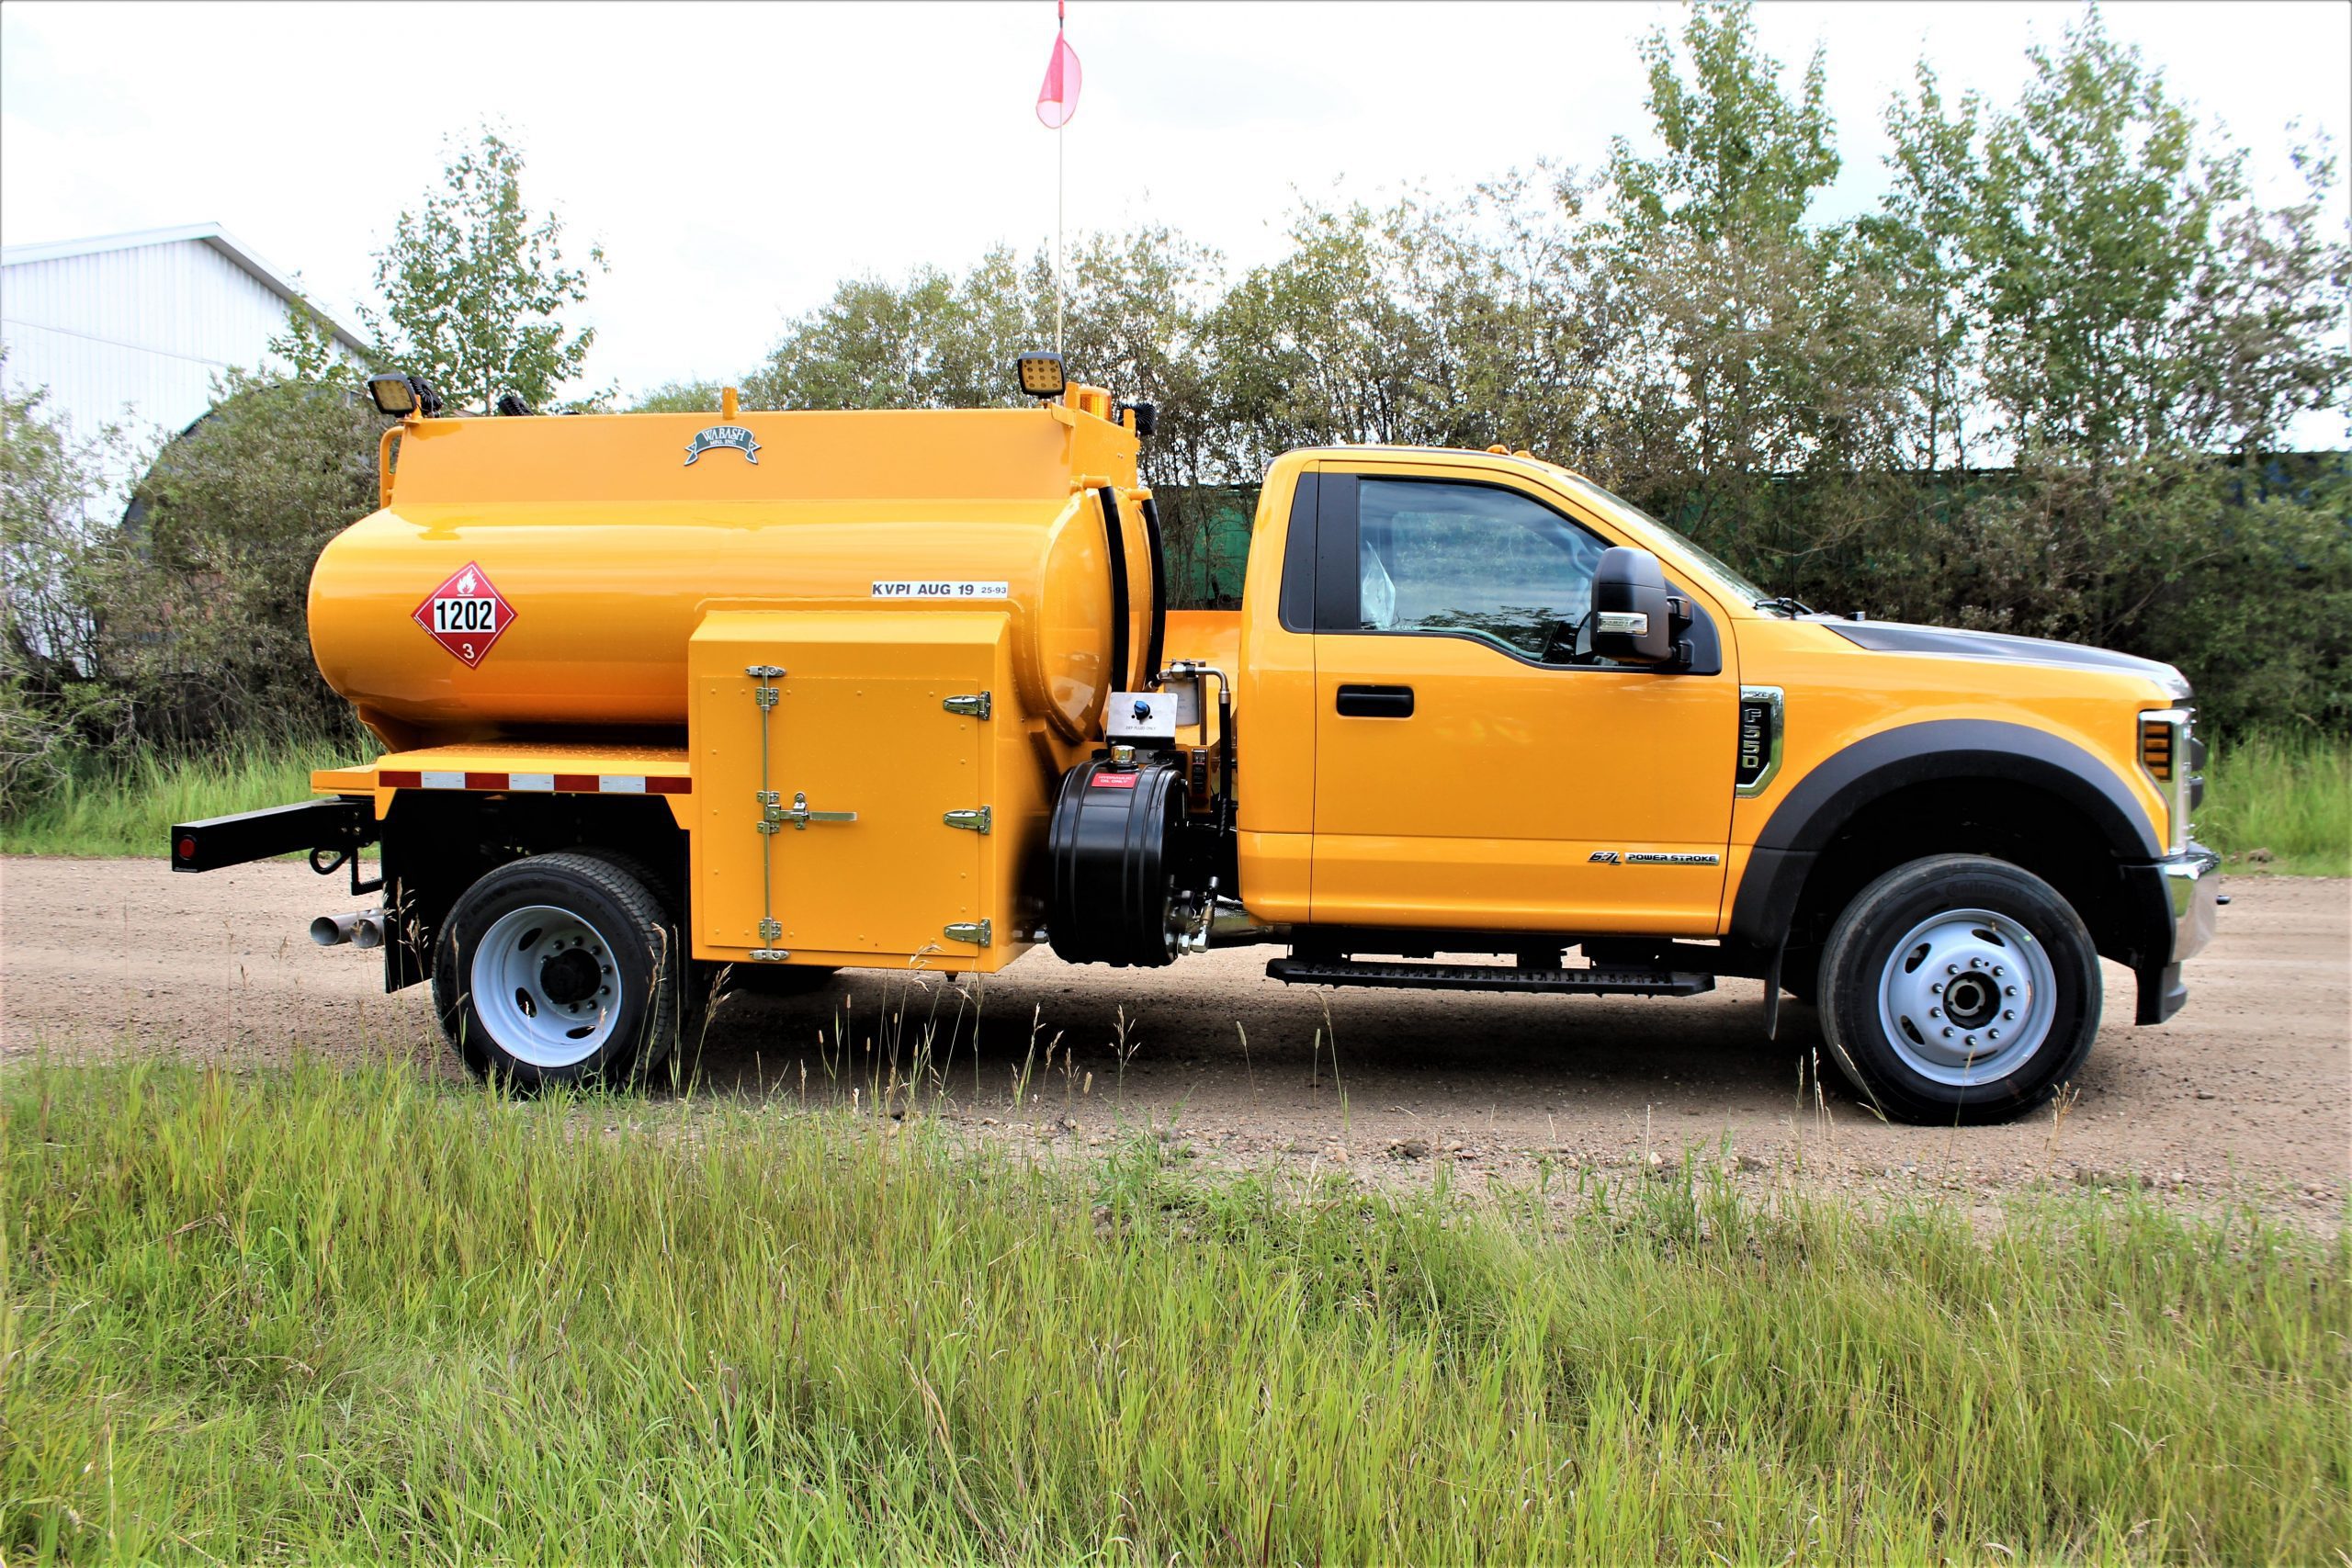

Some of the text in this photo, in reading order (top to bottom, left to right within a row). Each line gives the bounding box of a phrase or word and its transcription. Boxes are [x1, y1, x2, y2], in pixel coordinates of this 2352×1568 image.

[701, 427, 746, 442] WABASH
[872, 583, 1007, 595] KVPI AUG 19 25-93
[435, 600, 492, 631] 1202
[462, 643, 475, 660] 3
[1741, 707, 1762, 769] F550
[1589, 852, 1717, 864] 6.7L POWER STROKE
